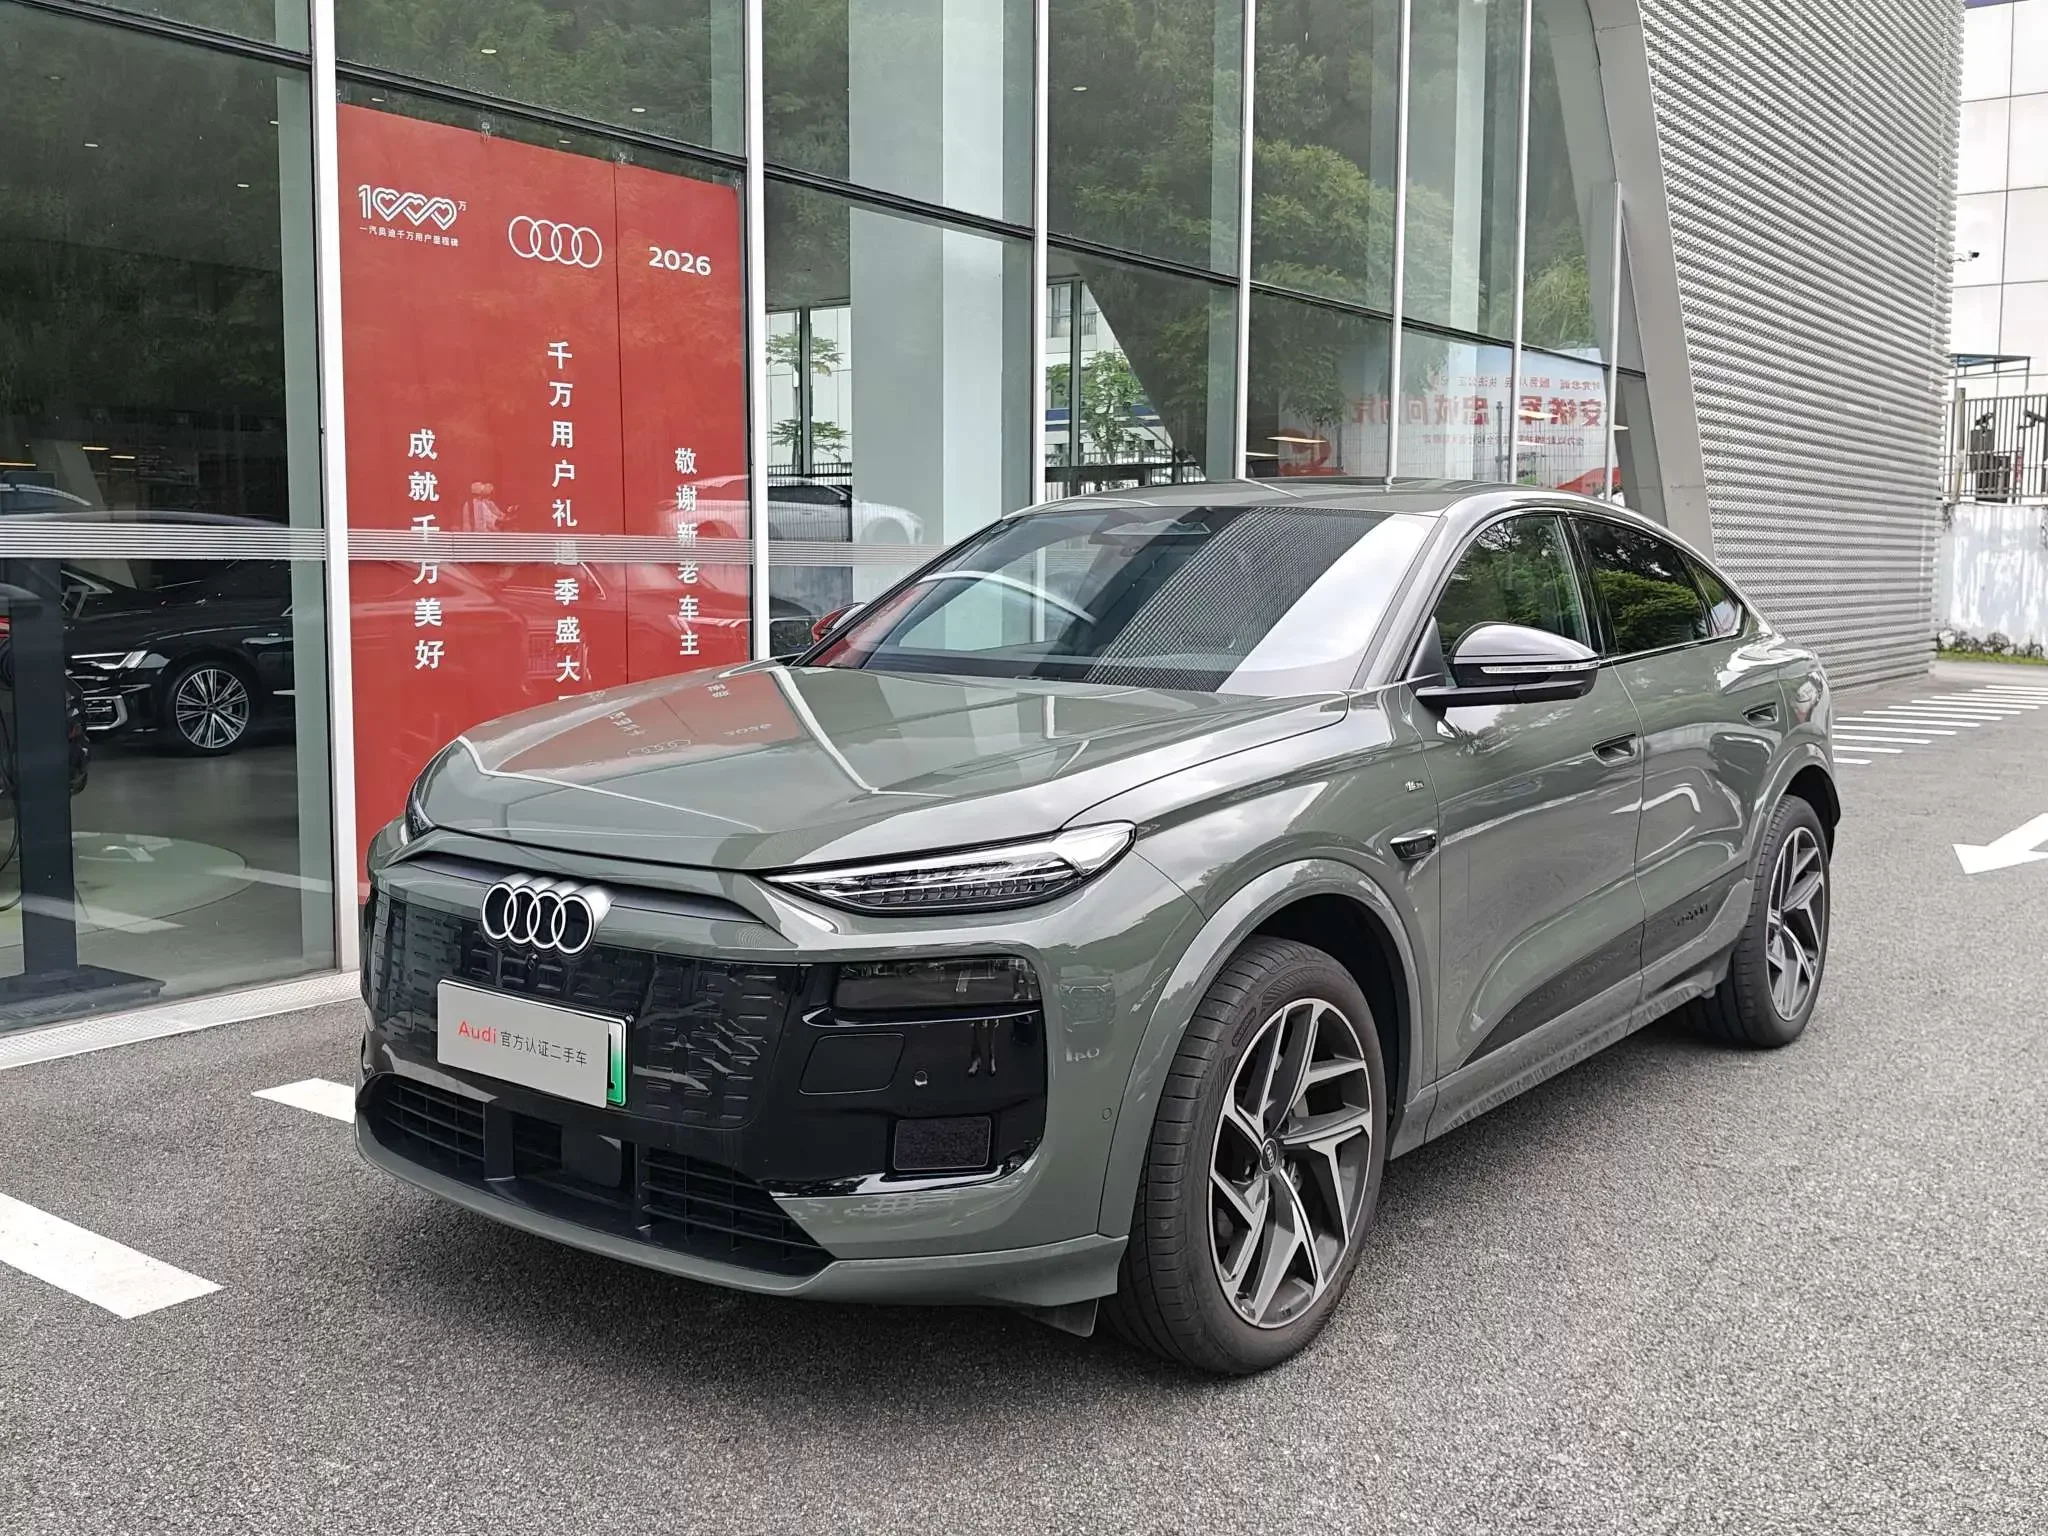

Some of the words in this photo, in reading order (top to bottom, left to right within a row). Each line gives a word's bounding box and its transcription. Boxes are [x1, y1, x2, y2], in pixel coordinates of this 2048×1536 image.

[648, 246, 711, 276] 2026
[408, 428, 445, 670] 成就千万美好
[547, 340, 581, 699] 千万用户礼遇季盛大
[675, 447, 700, 656] 敬谢新老车主
[458, 1020, 497, 1044] Audi
[500, 1030, 588, 1067] 官方认证二手车
